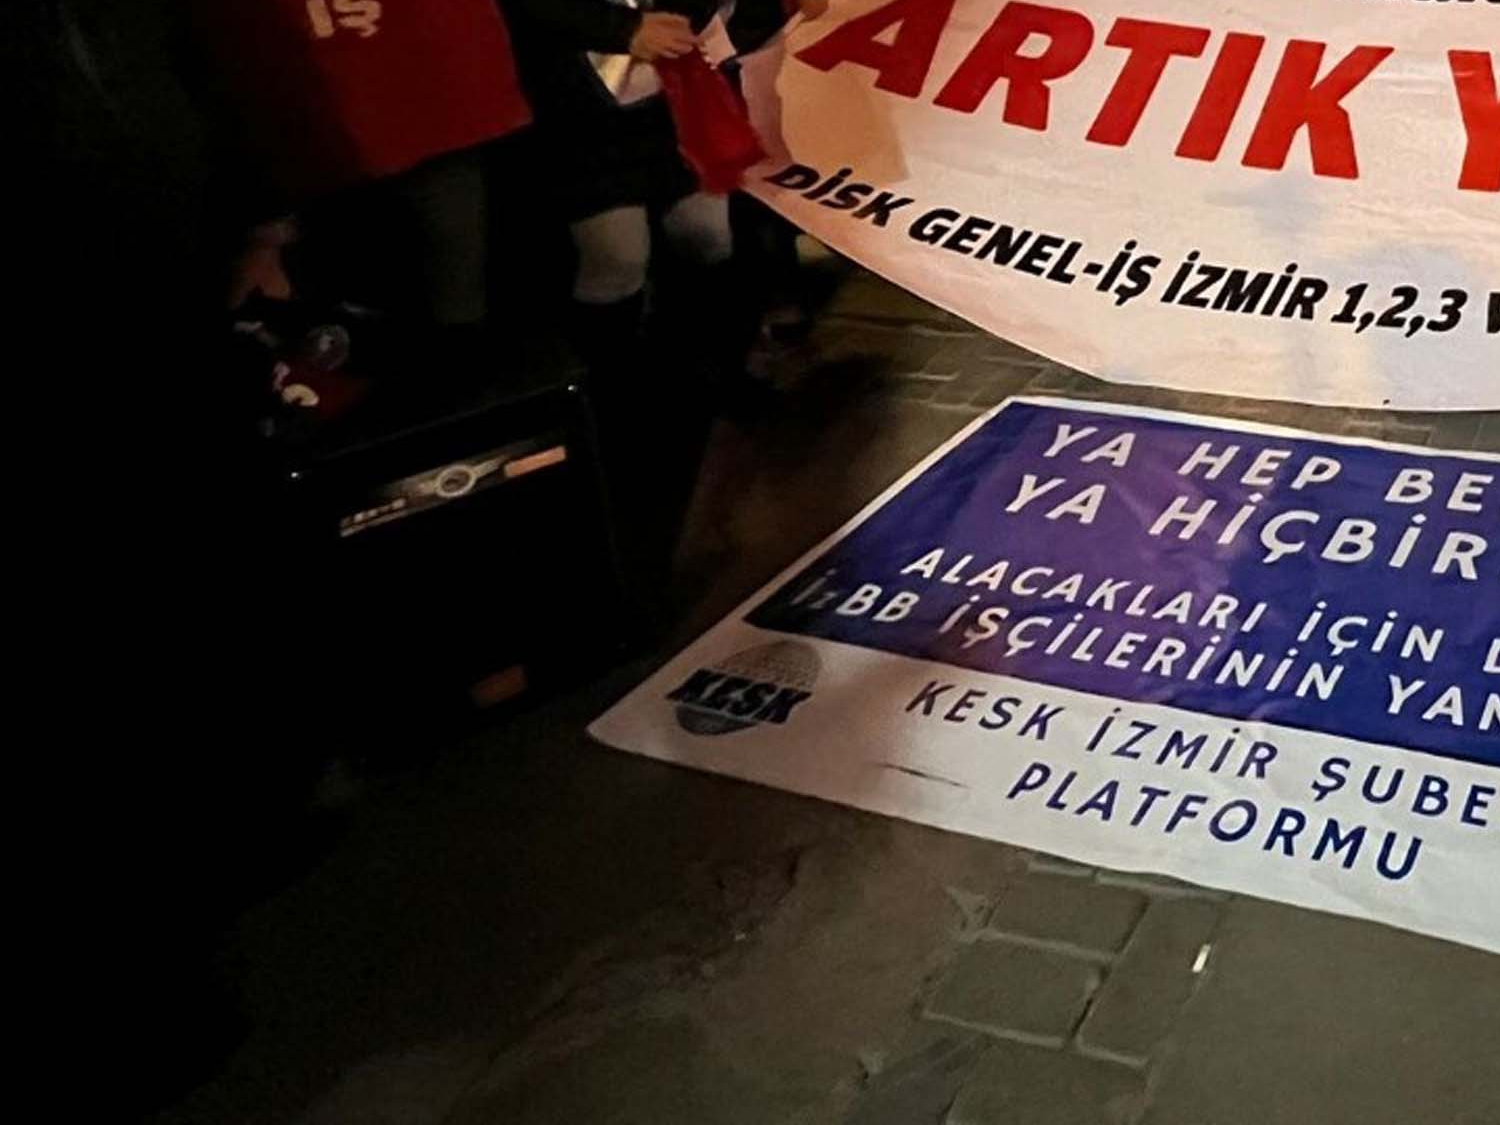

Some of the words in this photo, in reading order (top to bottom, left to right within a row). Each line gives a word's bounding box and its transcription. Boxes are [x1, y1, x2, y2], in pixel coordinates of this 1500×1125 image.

[907, 207, 1160, 306] GENEL-İŞ
[1160, 250, 1328, 320] İZMİR
[1330, 281, 1469, 333] 1,2,3
[1003, 474, 1106, 525] YA
[1042, 422, 1136, 468] YA
[1178, 432, 1342, 492] HEP
[901, 547, 1266, 634] ALACAKLARI
[1297, 599, 1445, 663] İÇİN
[938, 594, 1345, 701] İŞÇİLERİNİN
[904, 680, 1066, 742] KESK
[1085, 705, 1281, 782] İZMİR
[1005, 760, 1424, 881] PLATFORMU
